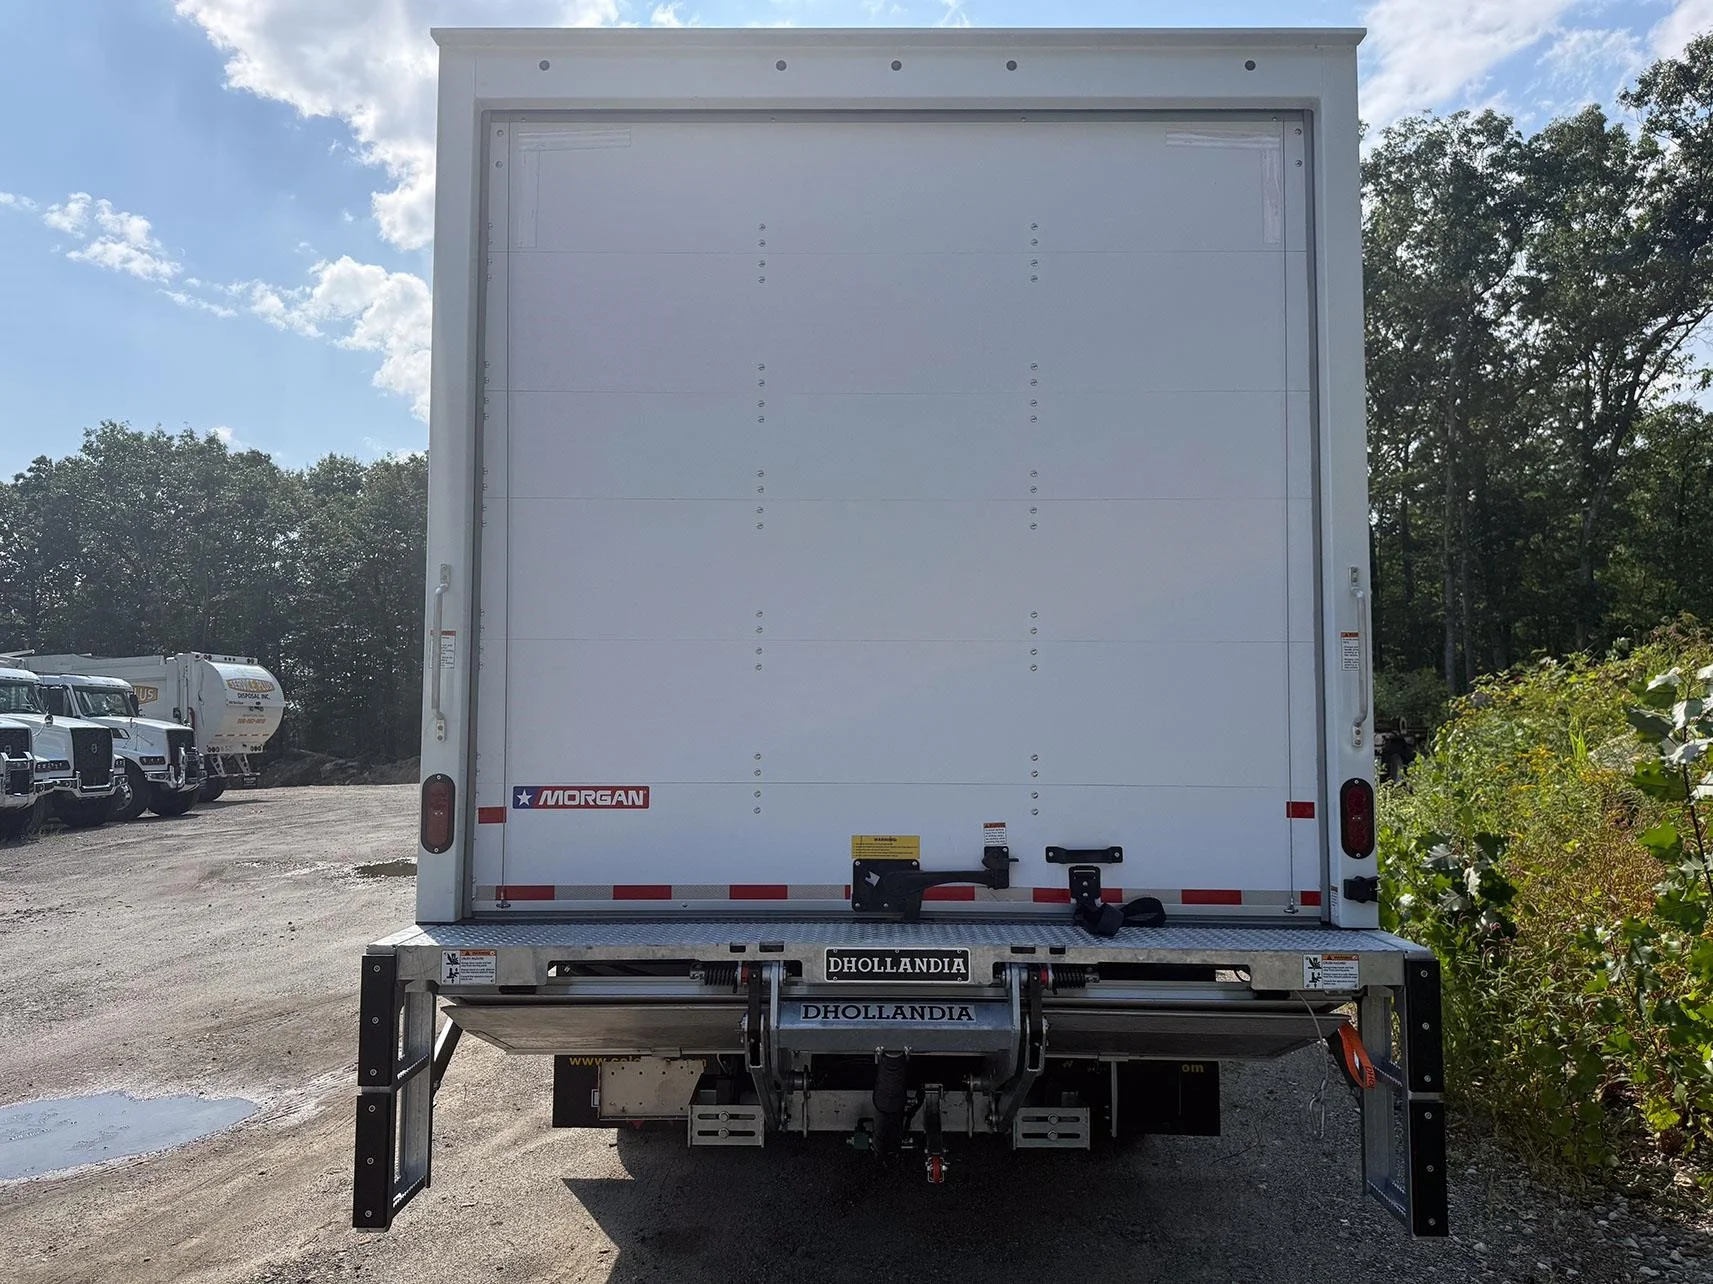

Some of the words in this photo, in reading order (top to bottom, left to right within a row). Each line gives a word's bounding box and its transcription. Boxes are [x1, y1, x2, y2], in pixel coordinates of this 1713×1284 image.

[538, 789, 644, 806] MORGAN
[828, 956, 967, 974] DHOLLANDIA
[802, 1004, 975, 1021] DHOLLANDIA
